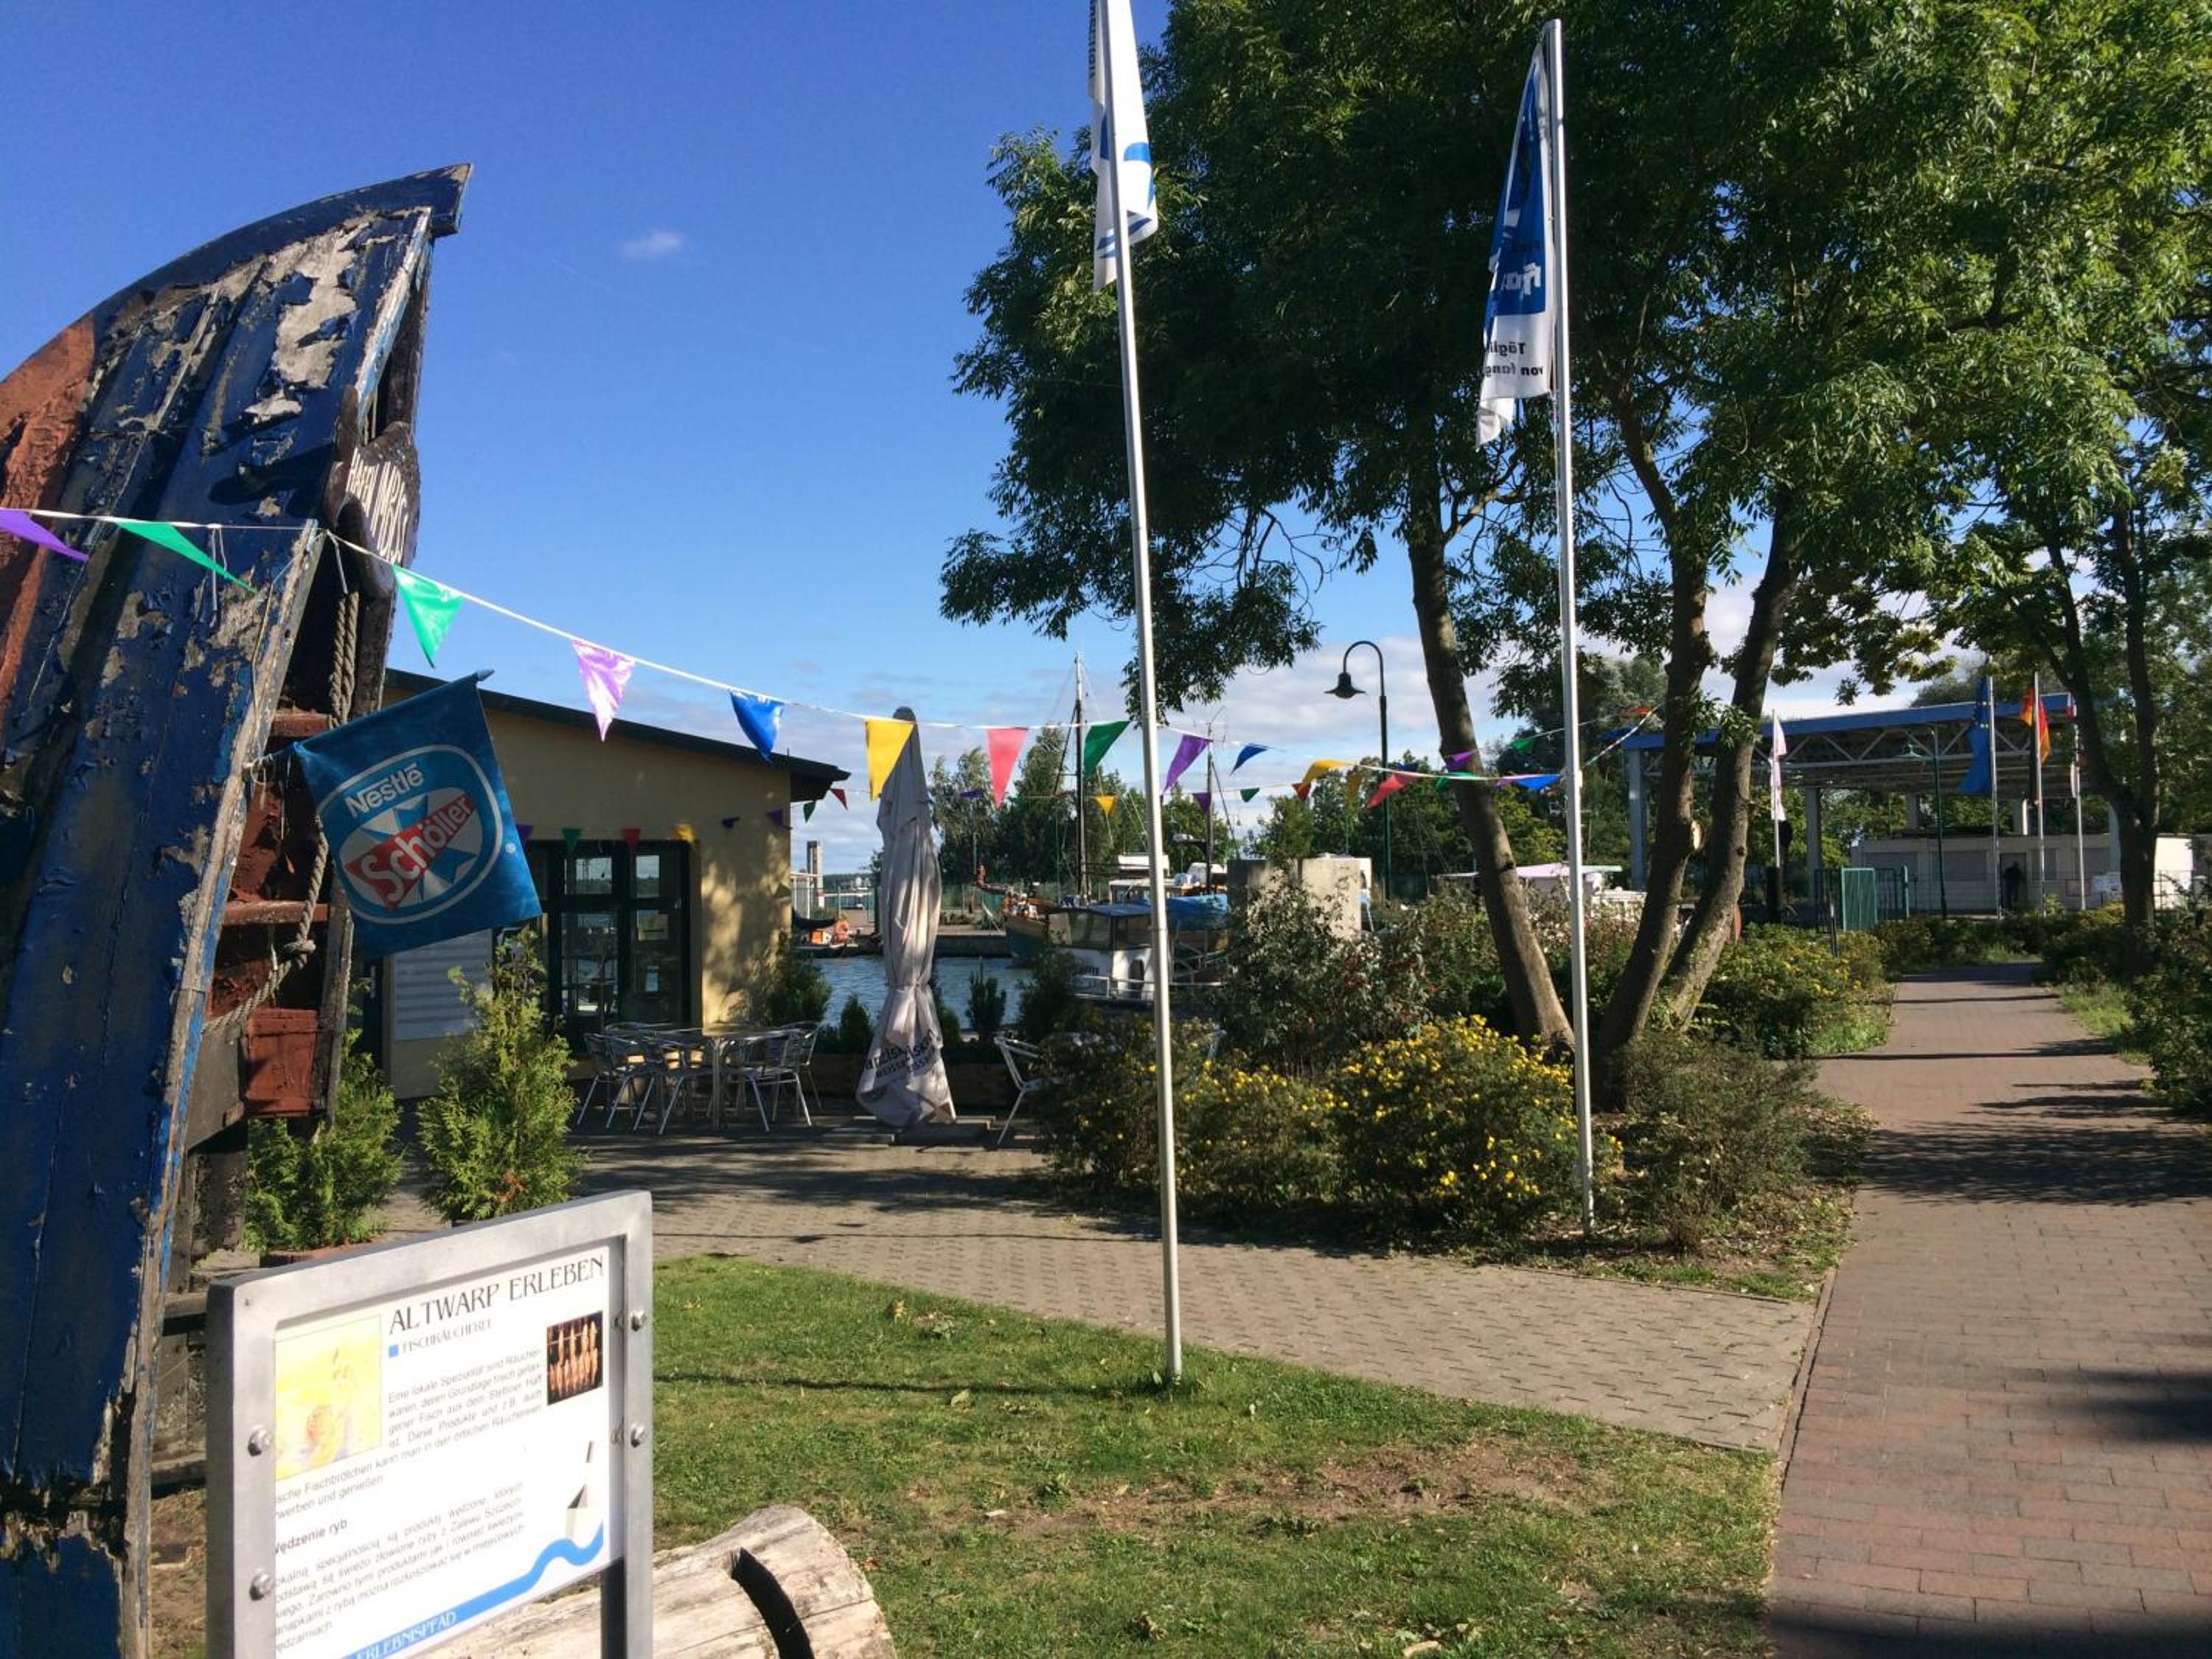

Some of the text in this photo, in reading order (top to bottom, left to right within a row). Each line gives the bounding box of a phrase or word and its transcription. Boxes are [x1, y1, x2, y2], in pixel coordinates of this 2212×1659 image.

[344, 762, 425, 819] Nestlé
[361, 796, 472, 902] Schöller
[389, 1254, 604, 1335] ALTWARP ERLEBEN
[328, 1517, 348, 1536] ryb
